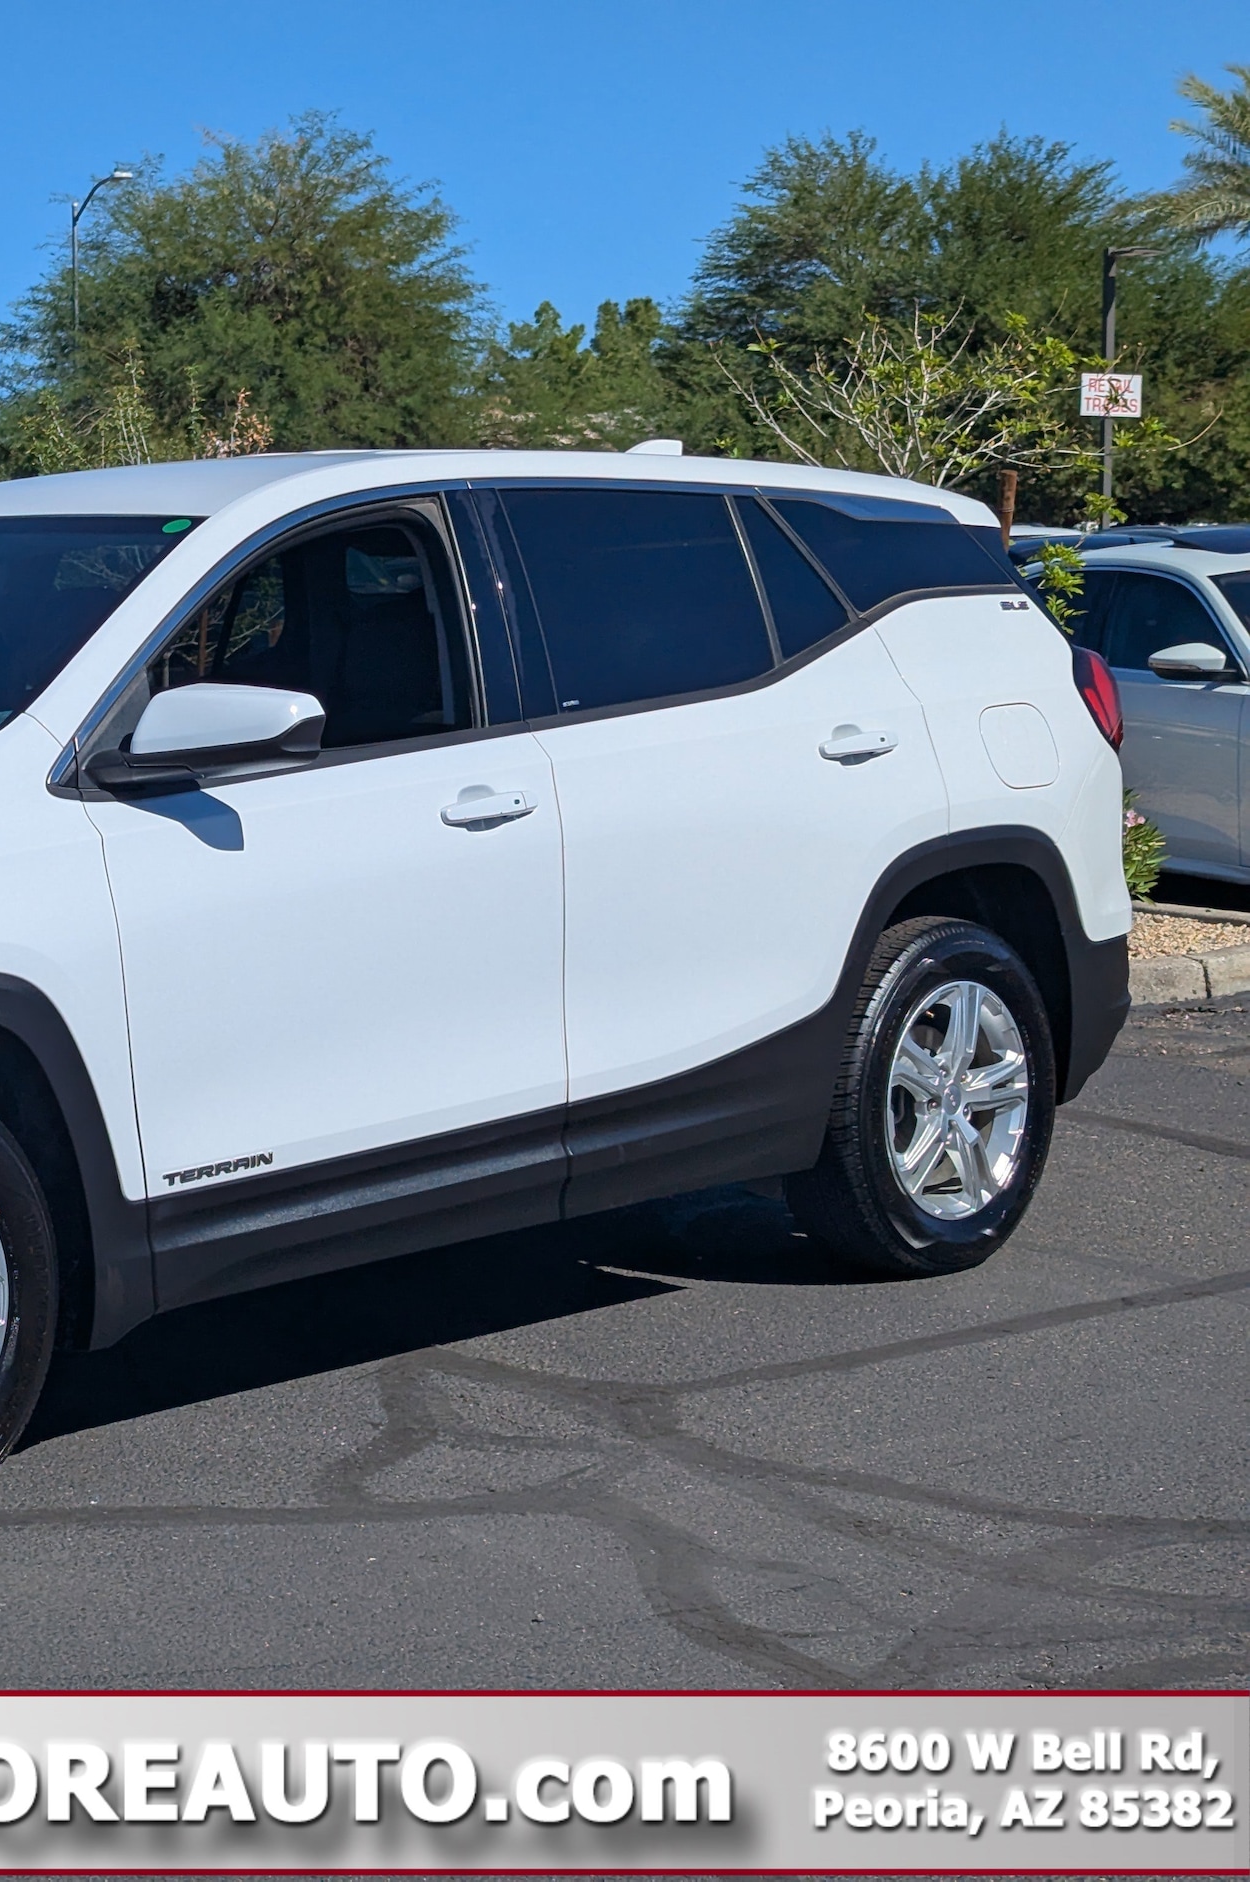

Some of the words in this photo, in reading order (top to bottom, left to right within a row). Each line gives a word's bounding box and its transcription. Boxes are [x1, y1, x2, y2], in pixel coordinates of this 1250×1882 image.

[1088, 378, 1135, 393] REAIL
[1084, 397, 1139, 413] TRES
[162, 1152, 274, 1187] TERRAIN
